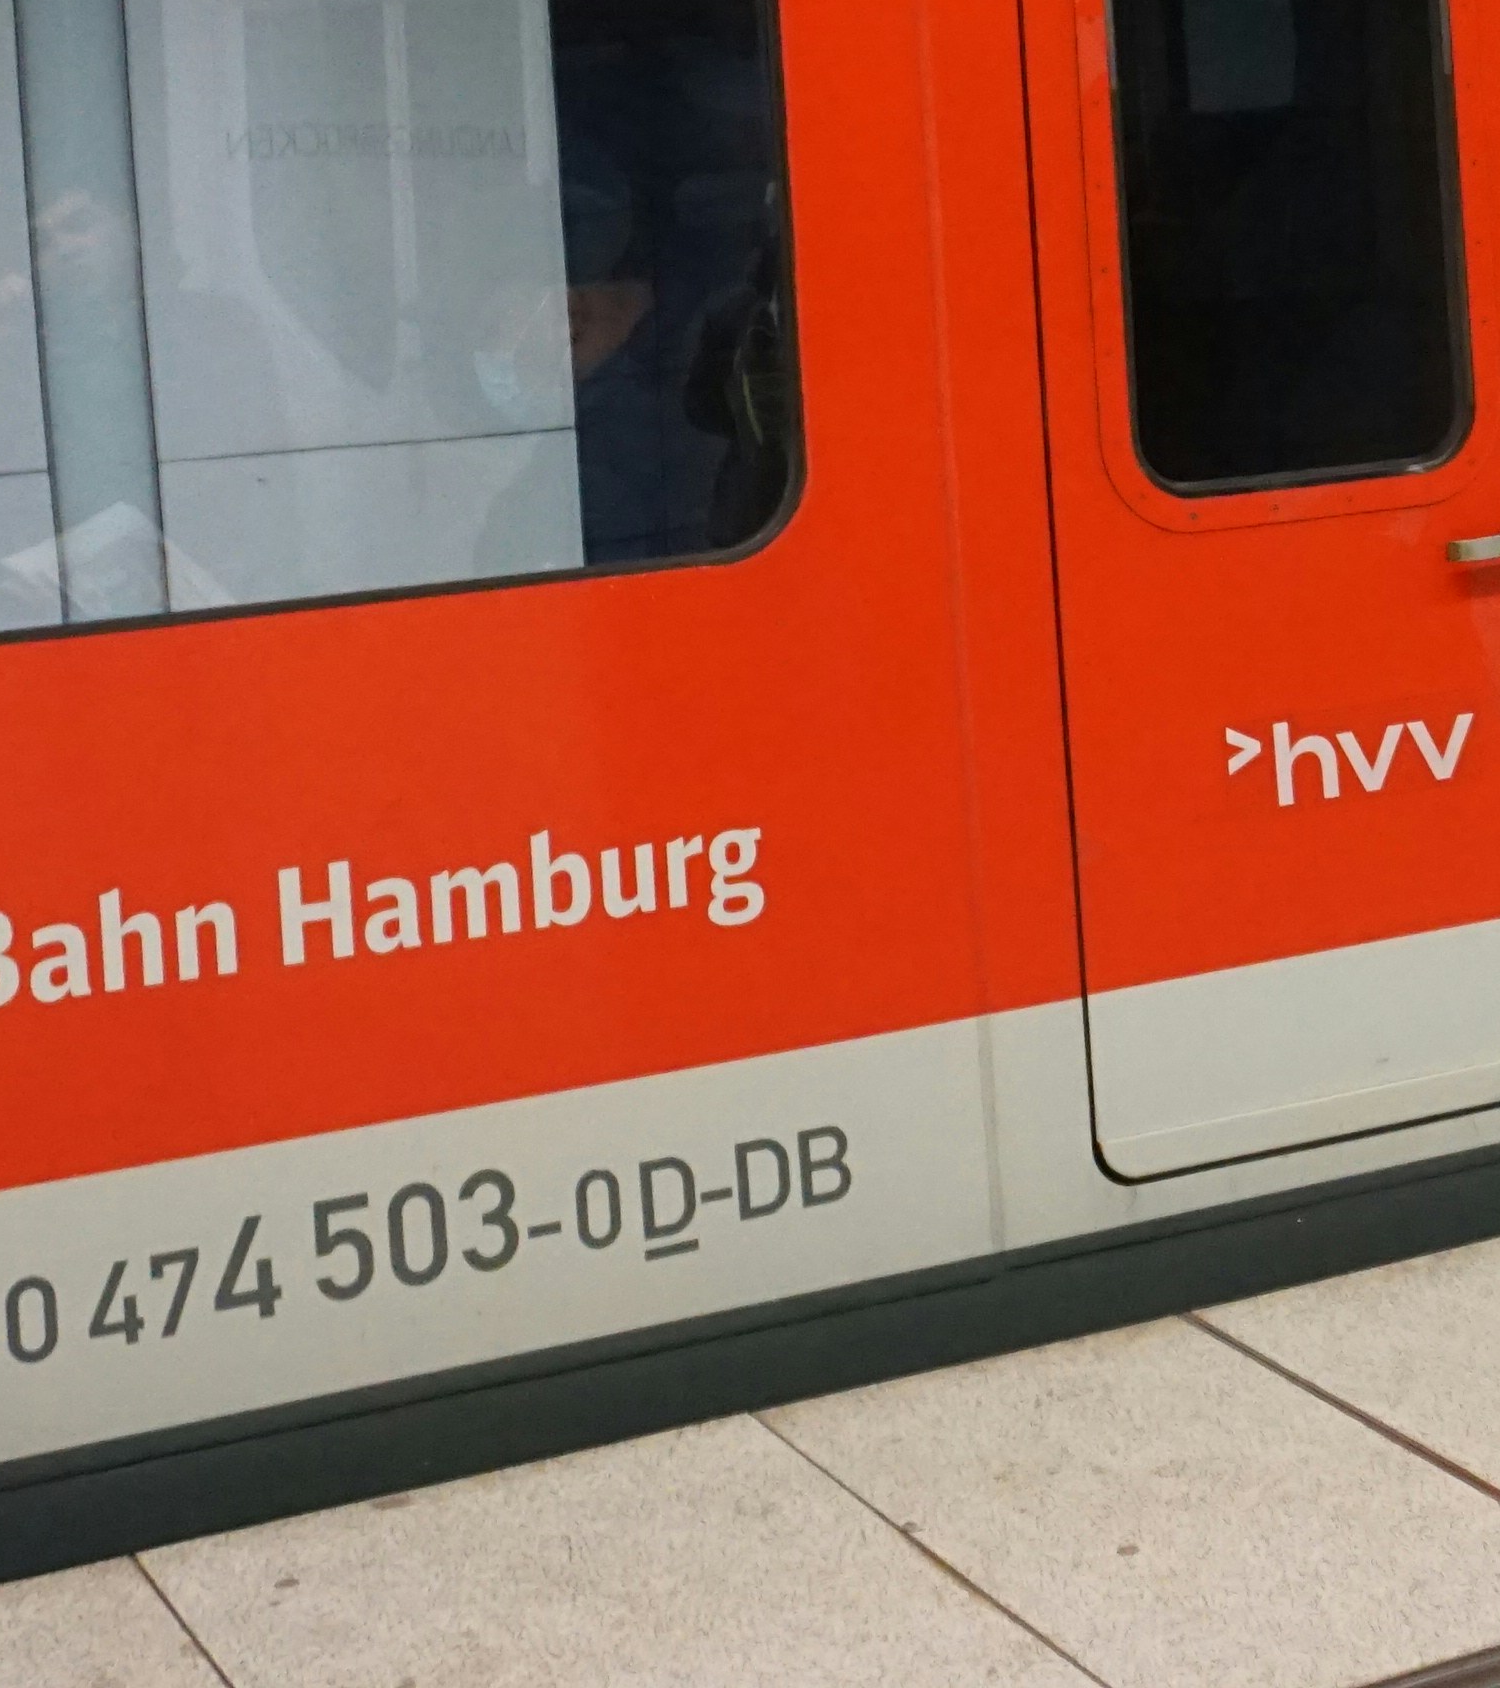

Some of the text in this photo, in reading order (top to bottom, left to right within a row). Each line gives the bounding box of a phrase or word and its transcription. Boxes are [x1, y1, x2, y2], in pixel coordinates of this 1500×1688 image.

[278, 825, 766, 965] Hamburg
[5, 1275, 59, 1363] 0
[88, 1215, 282, 1344] 474
